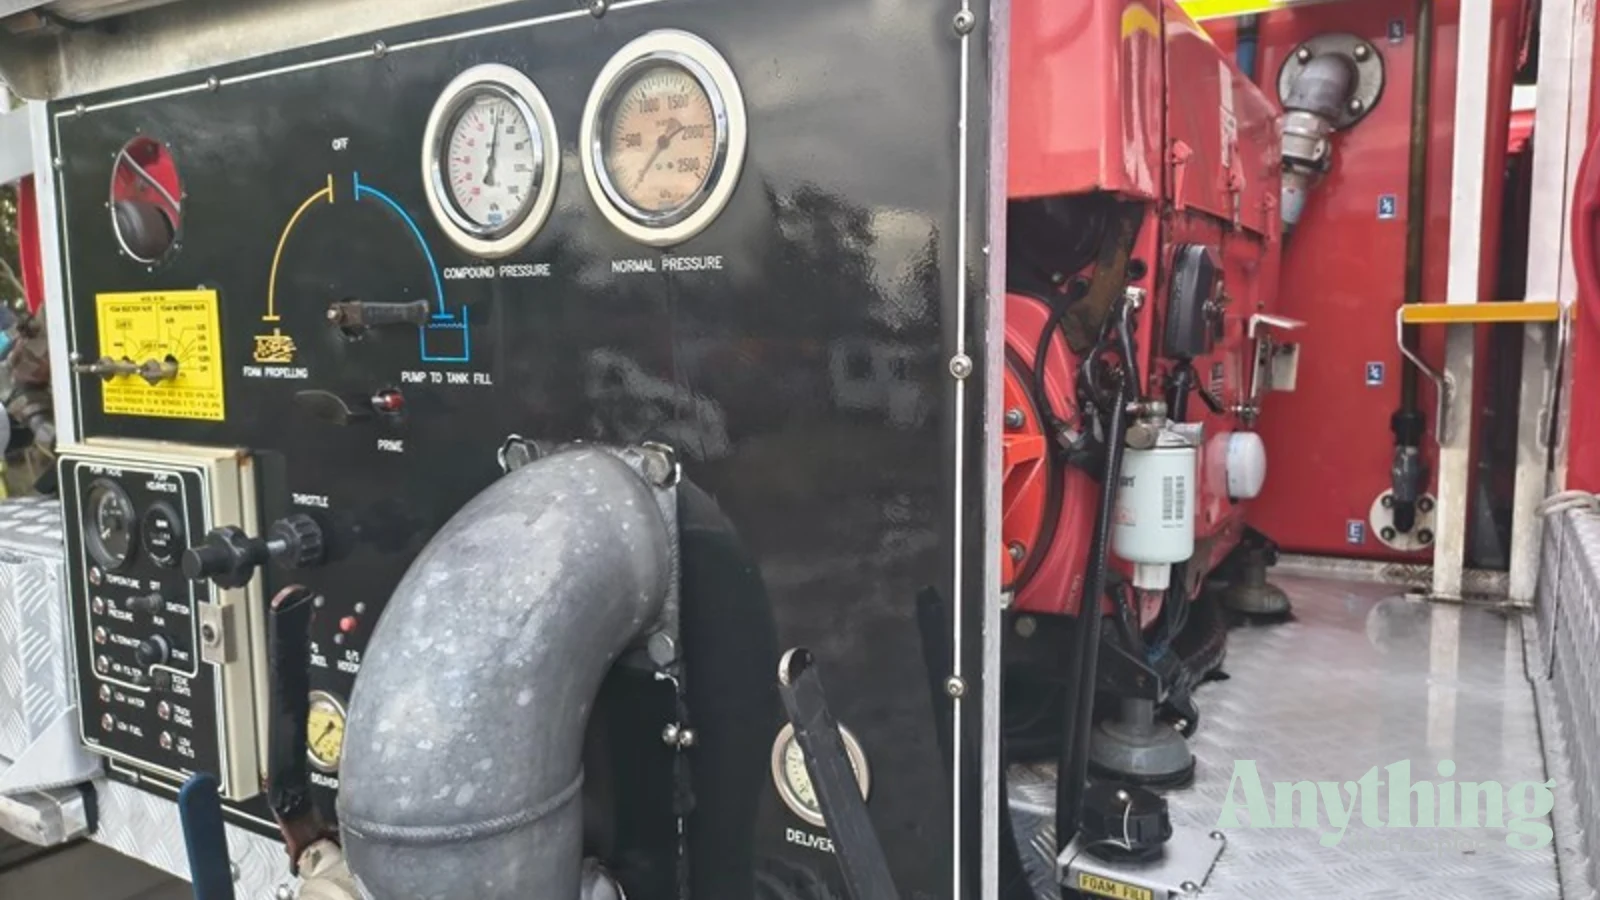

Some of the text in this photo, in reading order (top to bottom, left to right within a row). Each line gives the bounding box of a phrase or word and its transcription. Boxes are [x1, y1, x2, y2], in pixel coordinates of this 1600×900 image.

[444, 264, 550, 279] COMPOUND PRESSURE
[612, 256, 722, 272] NORMAL PRESSURE
[402, 372, 492, 384] PUMP TO TANK FILL
[293, 493, 328, 507] THROTTLE
[311, 772, 339, 788] DELIVER
[786, 828, 836, 853] DELIVER
[1081, 875, 1116, 895] FOAM
